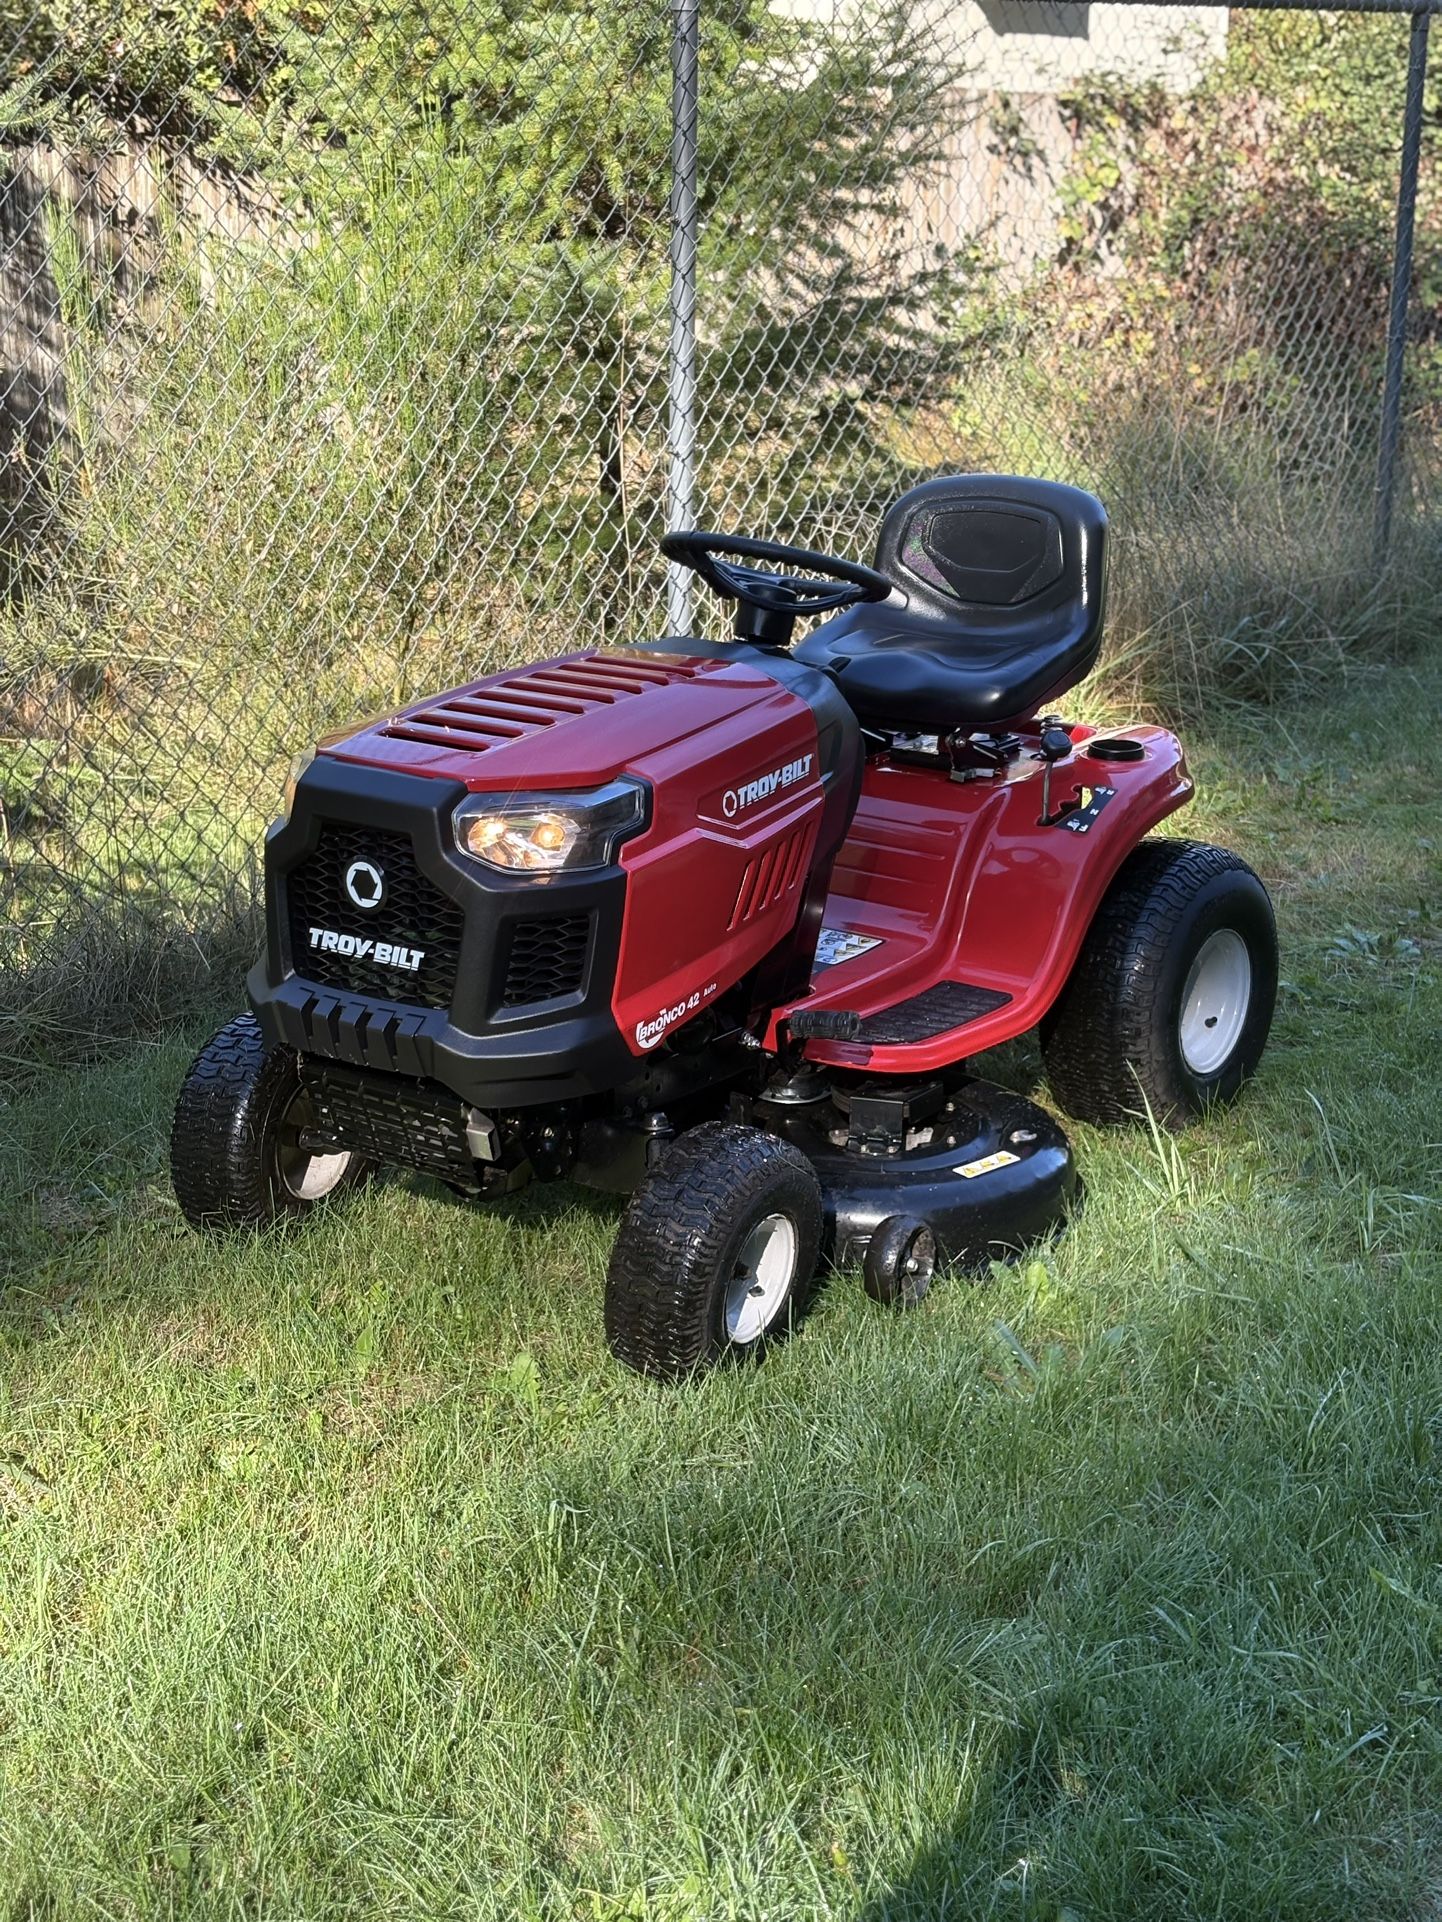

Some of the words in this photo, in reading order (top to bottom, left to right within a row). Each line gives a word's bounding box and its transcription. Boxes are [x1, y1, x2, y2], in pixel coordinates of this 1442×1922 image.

[737, 753, 813, 809] TROY-BILT
[309, 927, 425, 971] TROY-BILT
[638, 1002, 686, 1042] BRONCO
[687, 992, 700, 1009] 42
[703, 983, 717, 997] Auto
